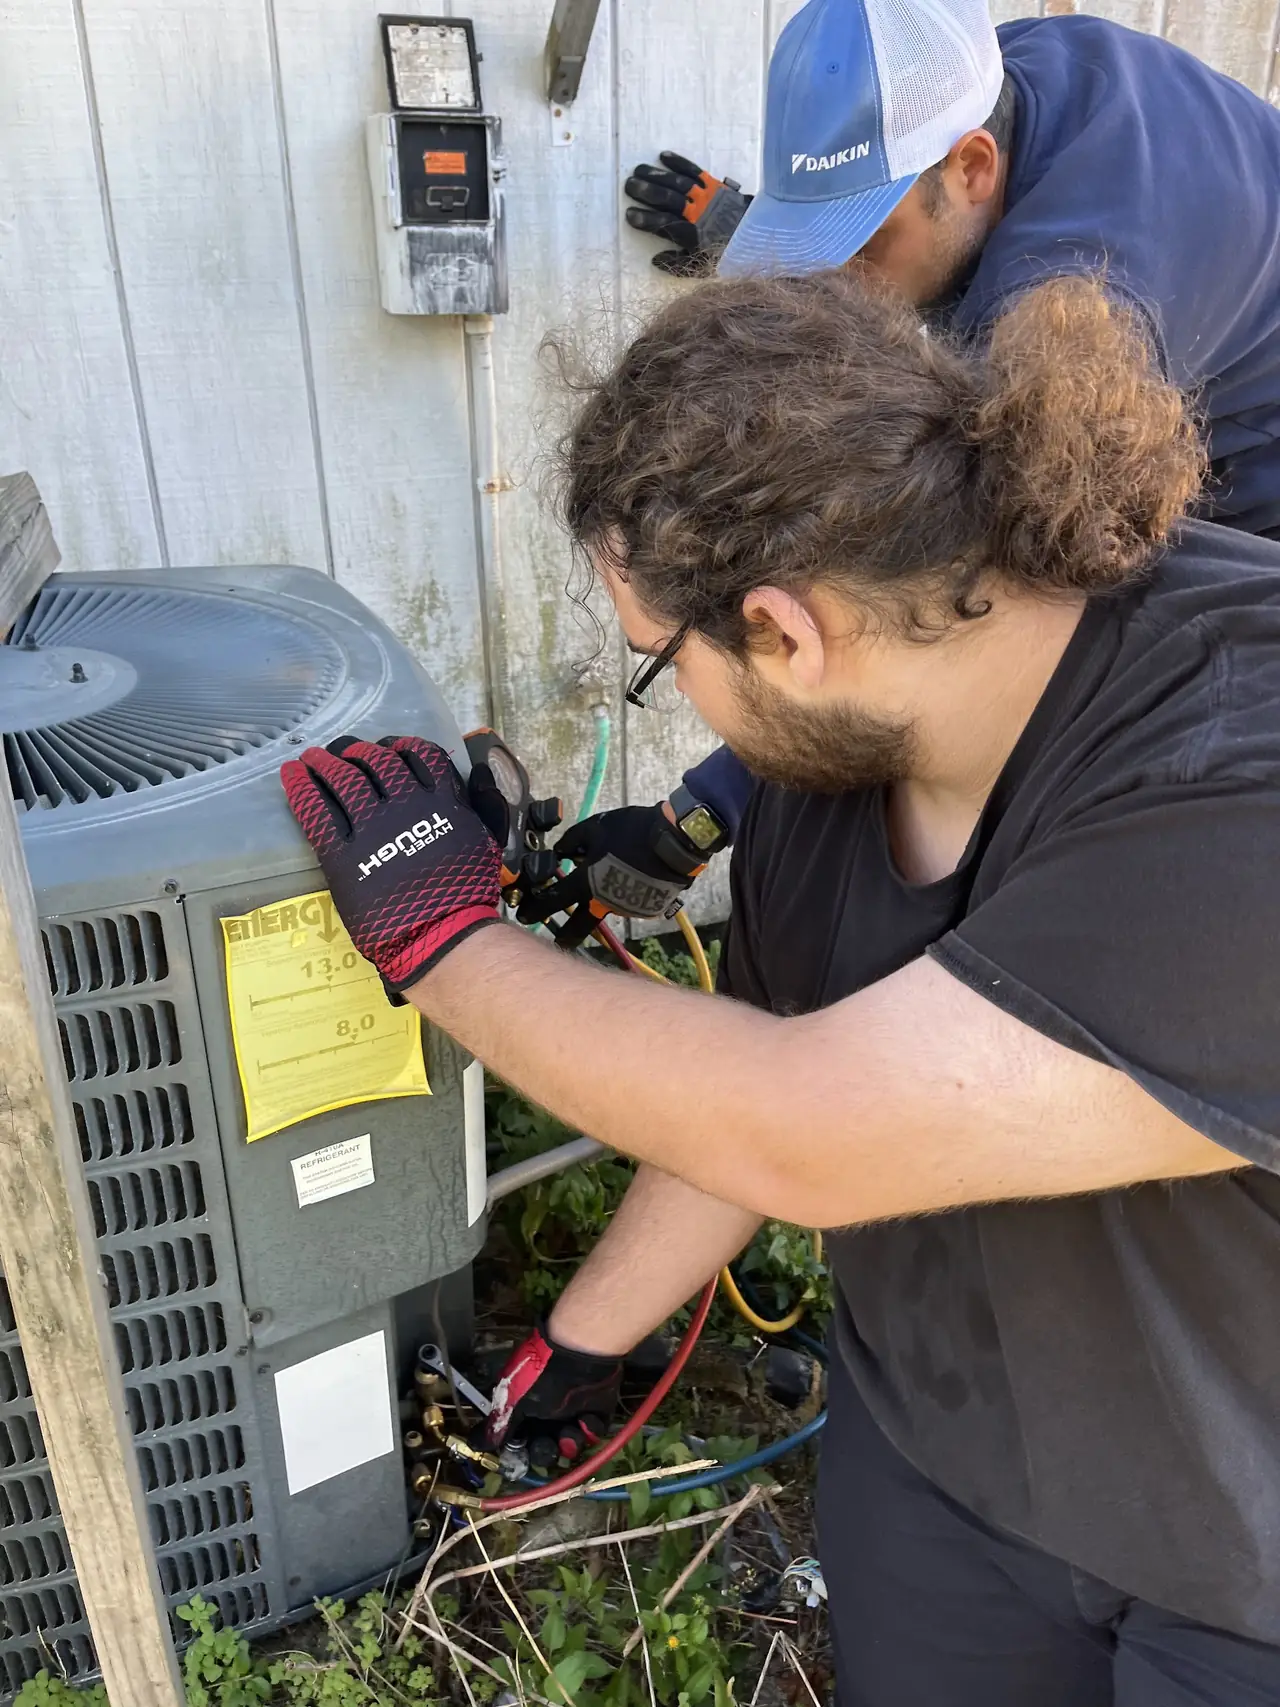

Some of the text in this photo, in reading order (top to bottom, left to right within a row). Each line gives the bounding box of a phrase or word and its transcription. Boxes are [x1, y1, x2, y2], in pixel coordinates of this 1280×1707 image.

[805, 140, 870, 172] DAIKIN
[357, 812, 449, 876] TOUGH
[403, 822, 454, 857] HYPER
[601, 877, 666, 912] TOOLS
[604, 864, 670, 900] KLEIN
[300, 951, 357, 978] 13.0
[336, 1013, 375, 1037] 8.0
[300, 1143, 361, 1170] REFRIGERANT
